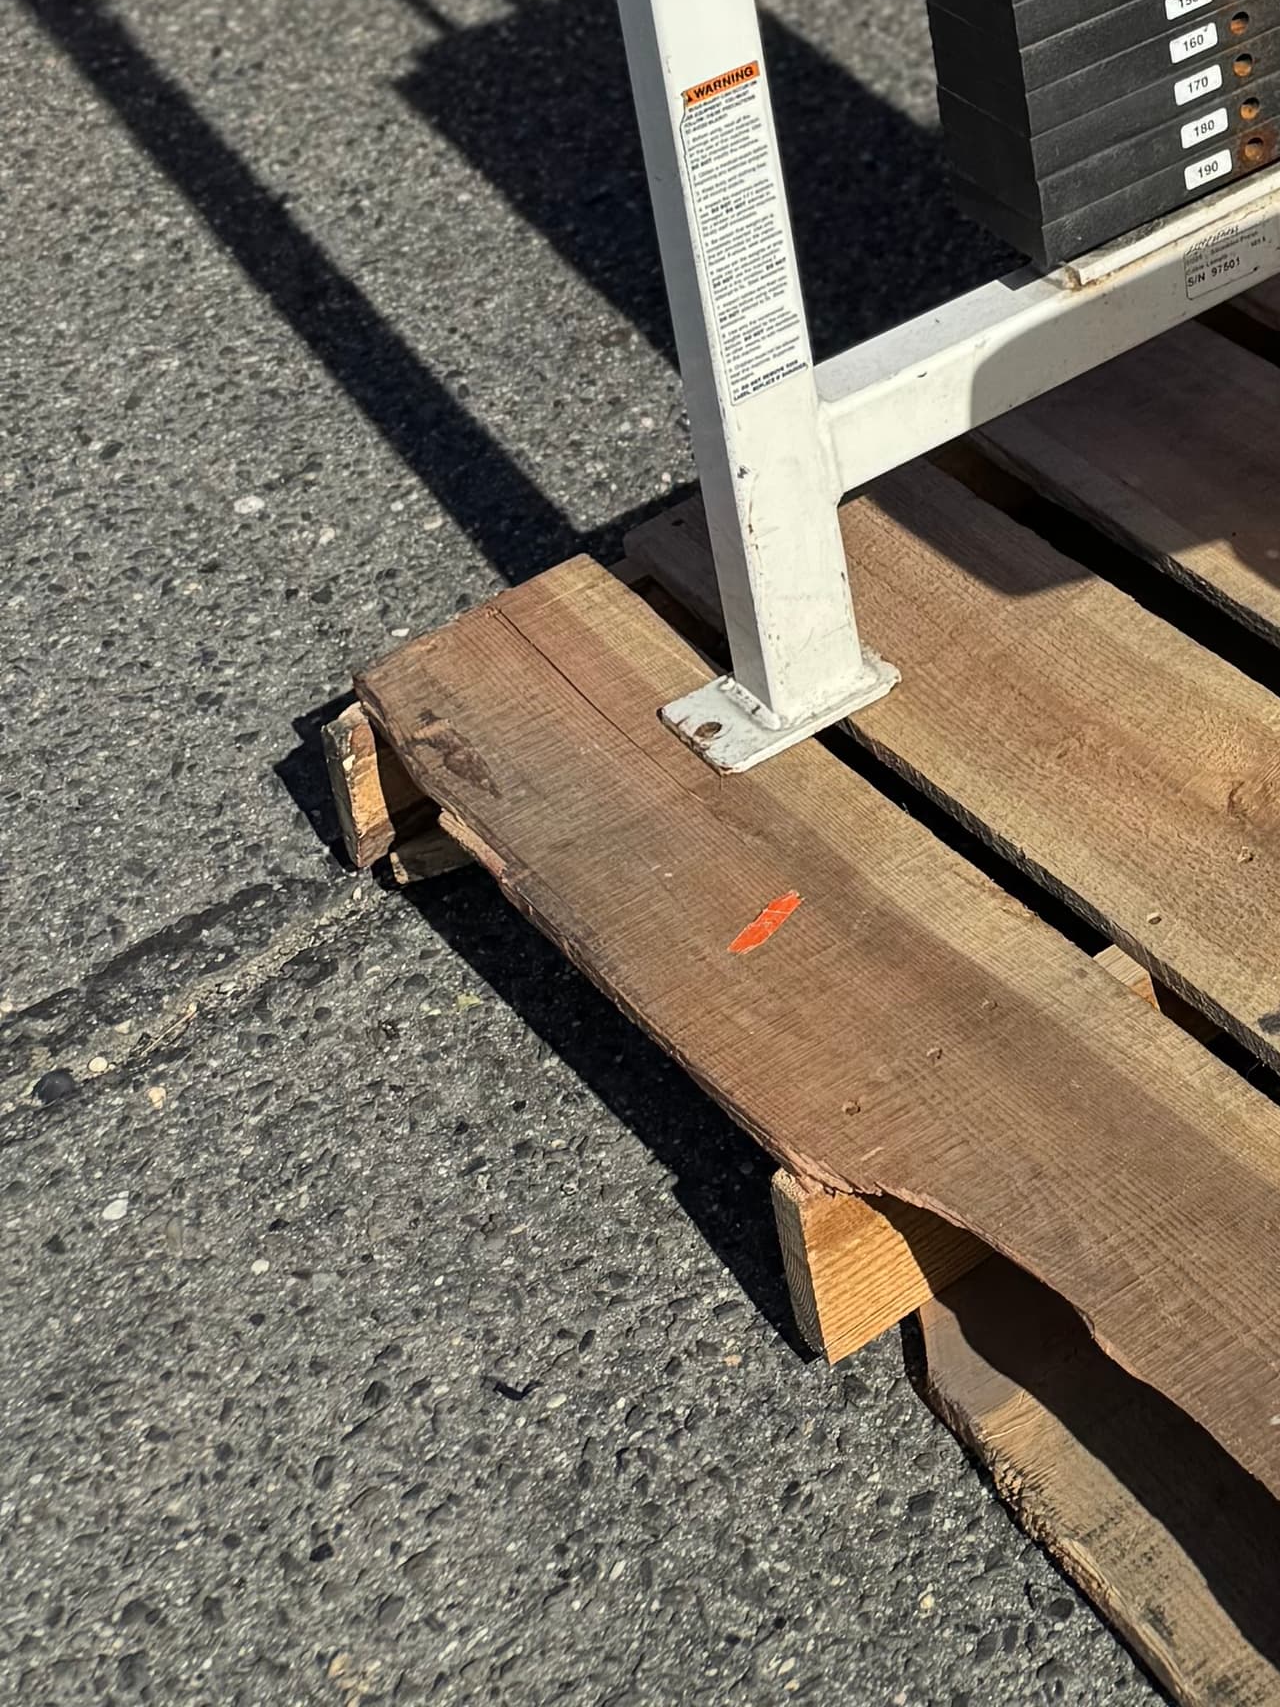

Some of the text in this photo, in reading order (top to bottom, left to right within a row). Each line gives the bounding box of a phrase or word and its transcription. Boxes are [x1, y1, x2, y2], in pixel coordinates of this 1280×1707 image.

[1183, 34, 1204, 51] 160
[693, 66, 754, 99] WARNING
[1188, 77, 1209, 93] 170
[1194, 120, 1215, 136] 180
[1199, 161, 1219, 178] 190
